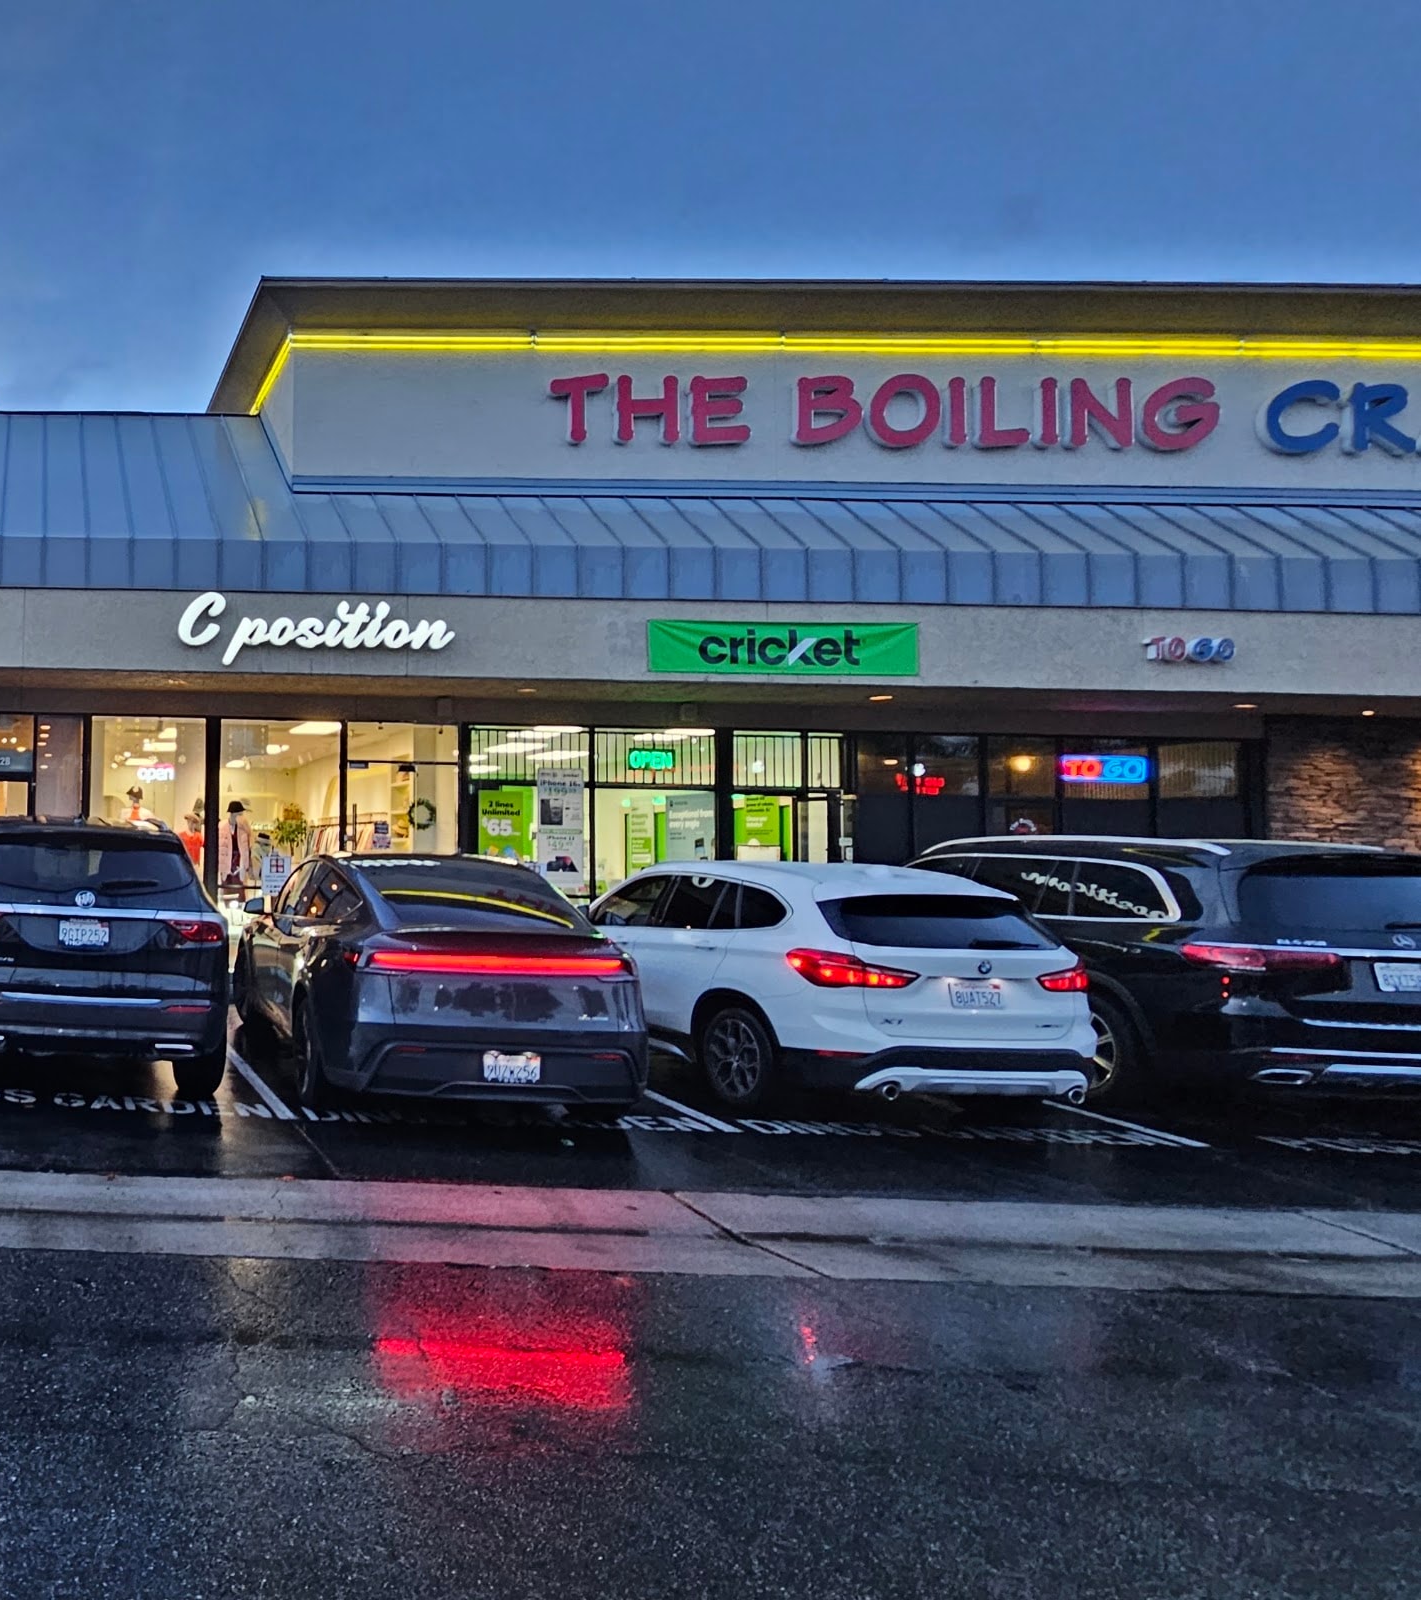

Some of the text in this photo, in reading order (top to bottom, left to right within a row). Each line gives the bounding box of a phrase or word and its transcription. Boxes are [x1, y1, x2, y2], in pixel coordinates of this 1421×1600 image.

[551, 373, 1421, 454] THE BOILING CR
[177, 591, 455, 666] C position
[698, 628, 861, 667] cricket
[629, 750, 674, 769] OPEN
